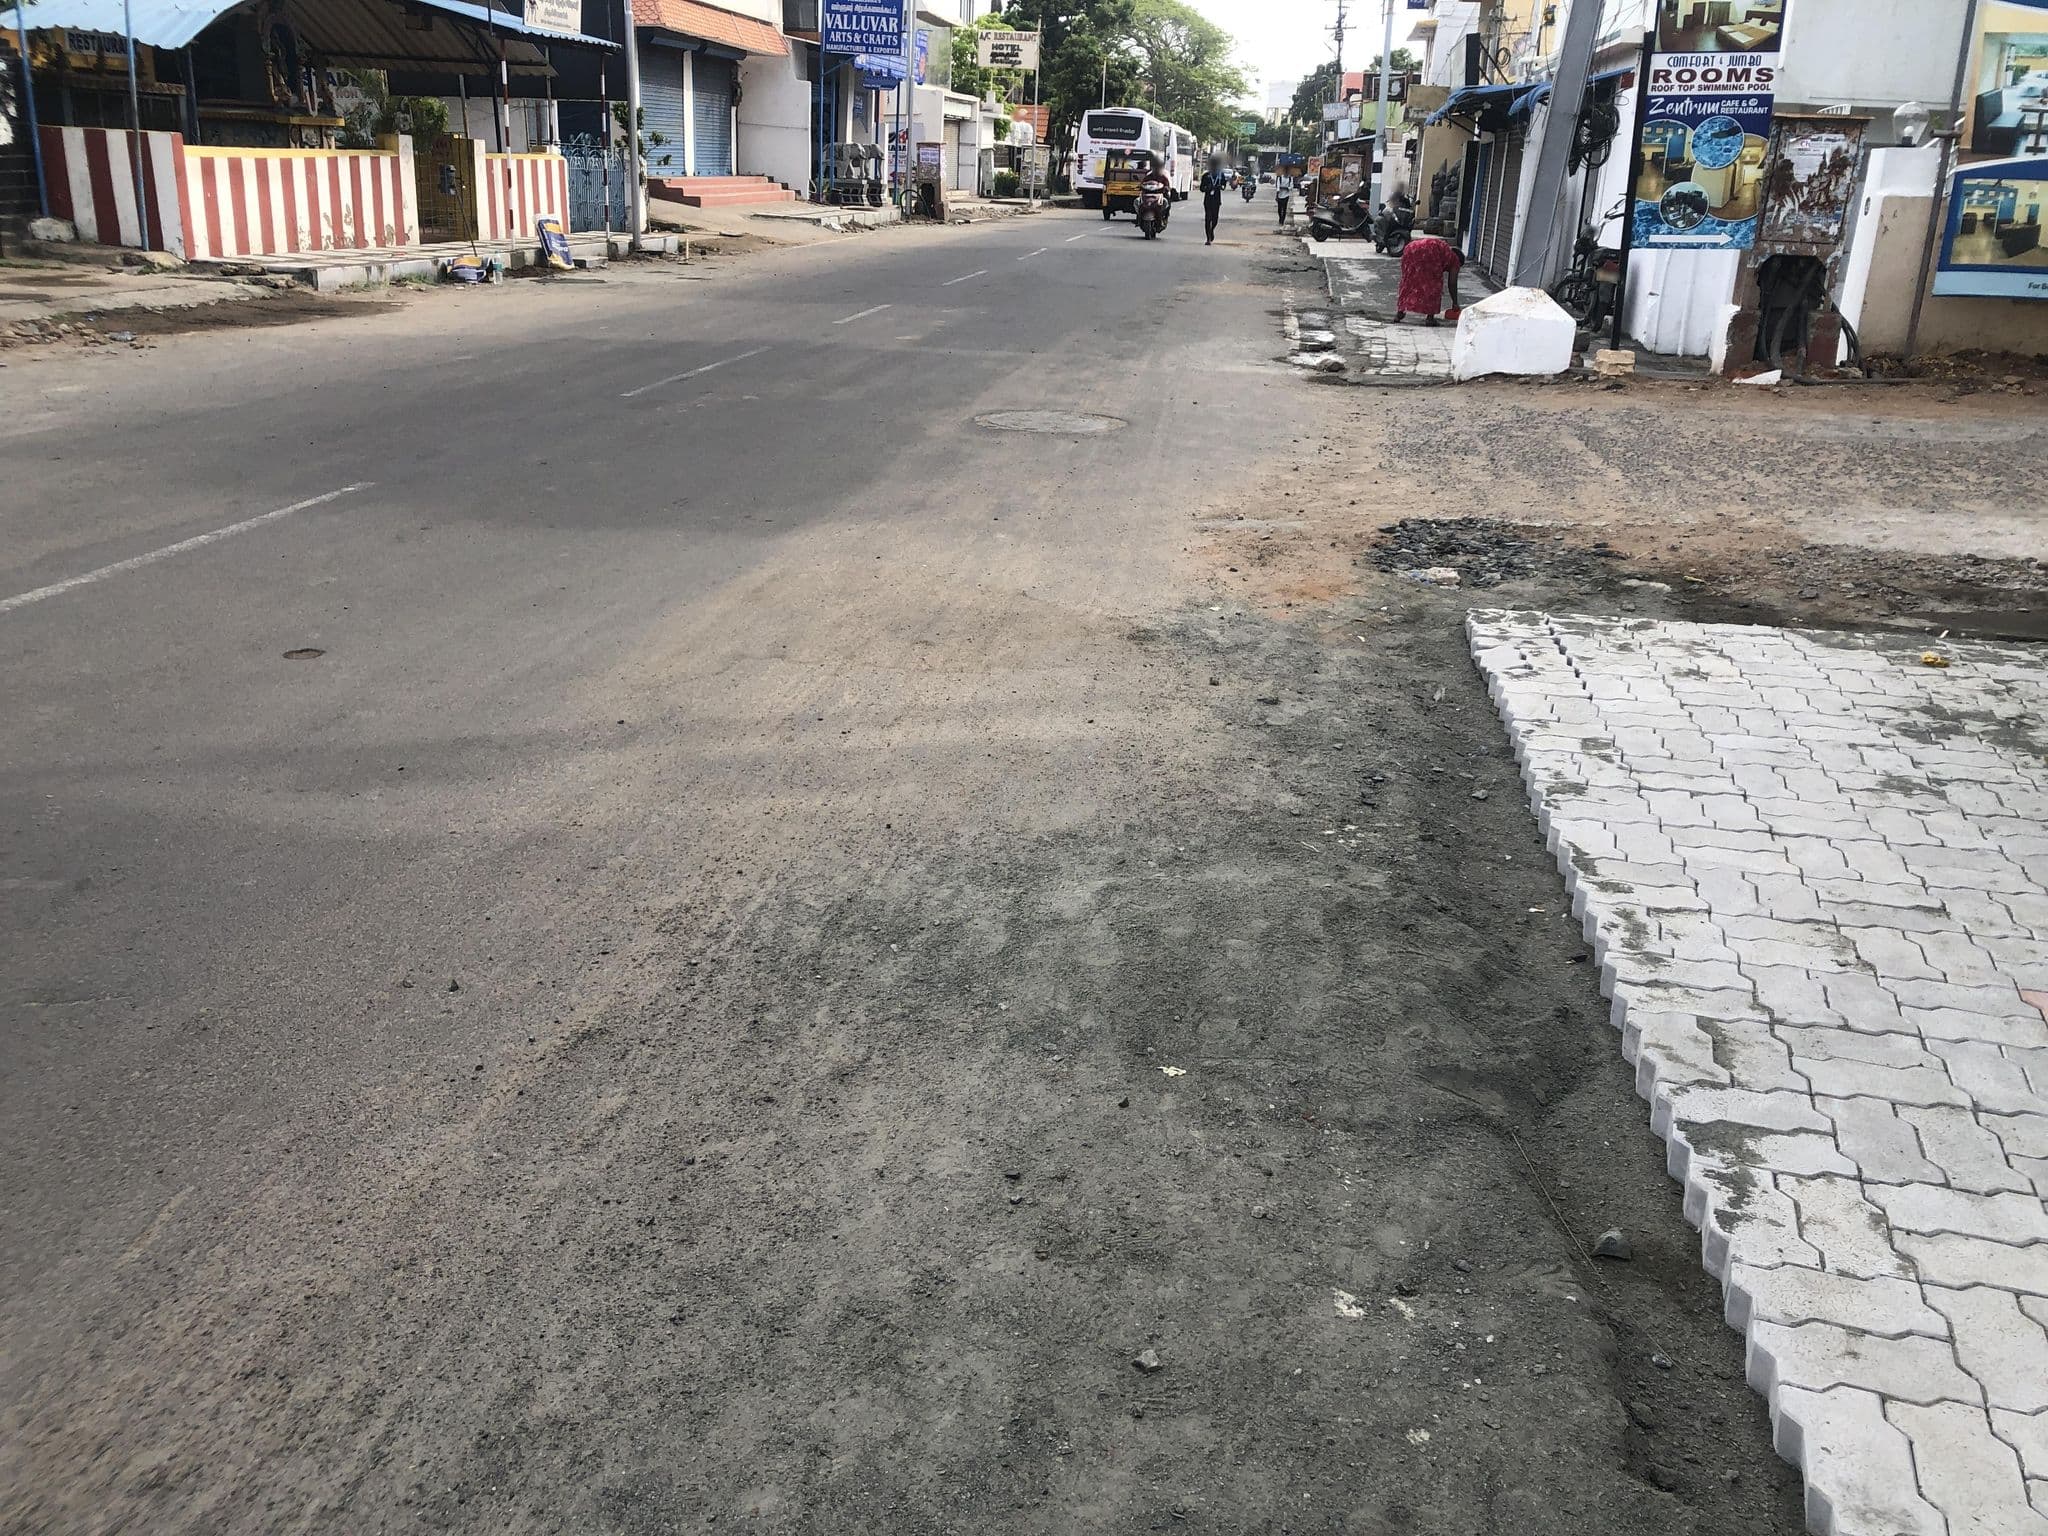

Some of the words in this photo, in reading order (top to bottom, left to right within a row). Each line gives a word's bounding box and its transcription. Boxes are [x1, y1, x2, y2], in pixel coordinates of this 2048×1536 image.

[826, 13, 898, 33] VALLUVAR
[829, 31, 852, 42] ARTS
[853, 33, 861, 44] &
[862, 33, 898, 46] CRAFTS
[994, 31, 1038, 42] RESTAURANT
[826, 44, 866, 53] MANUFACTURER
[991, 43, 1023, 51] HOTEL
[1667, 55, 1716, 67] COMFORT
[1727, 55, 1762, 67] JUMBO
[1652, 67, 1774, 83] ROOMS
[1651, 84, 1675, 92] ROOF
[1678, 84, 1695, 92] TOP
[1698, 83, 1745, 92] SWIMMING
[1747, 83, 1772, 91] POOL
[1649, 97, 1721, 116] Zentrum
